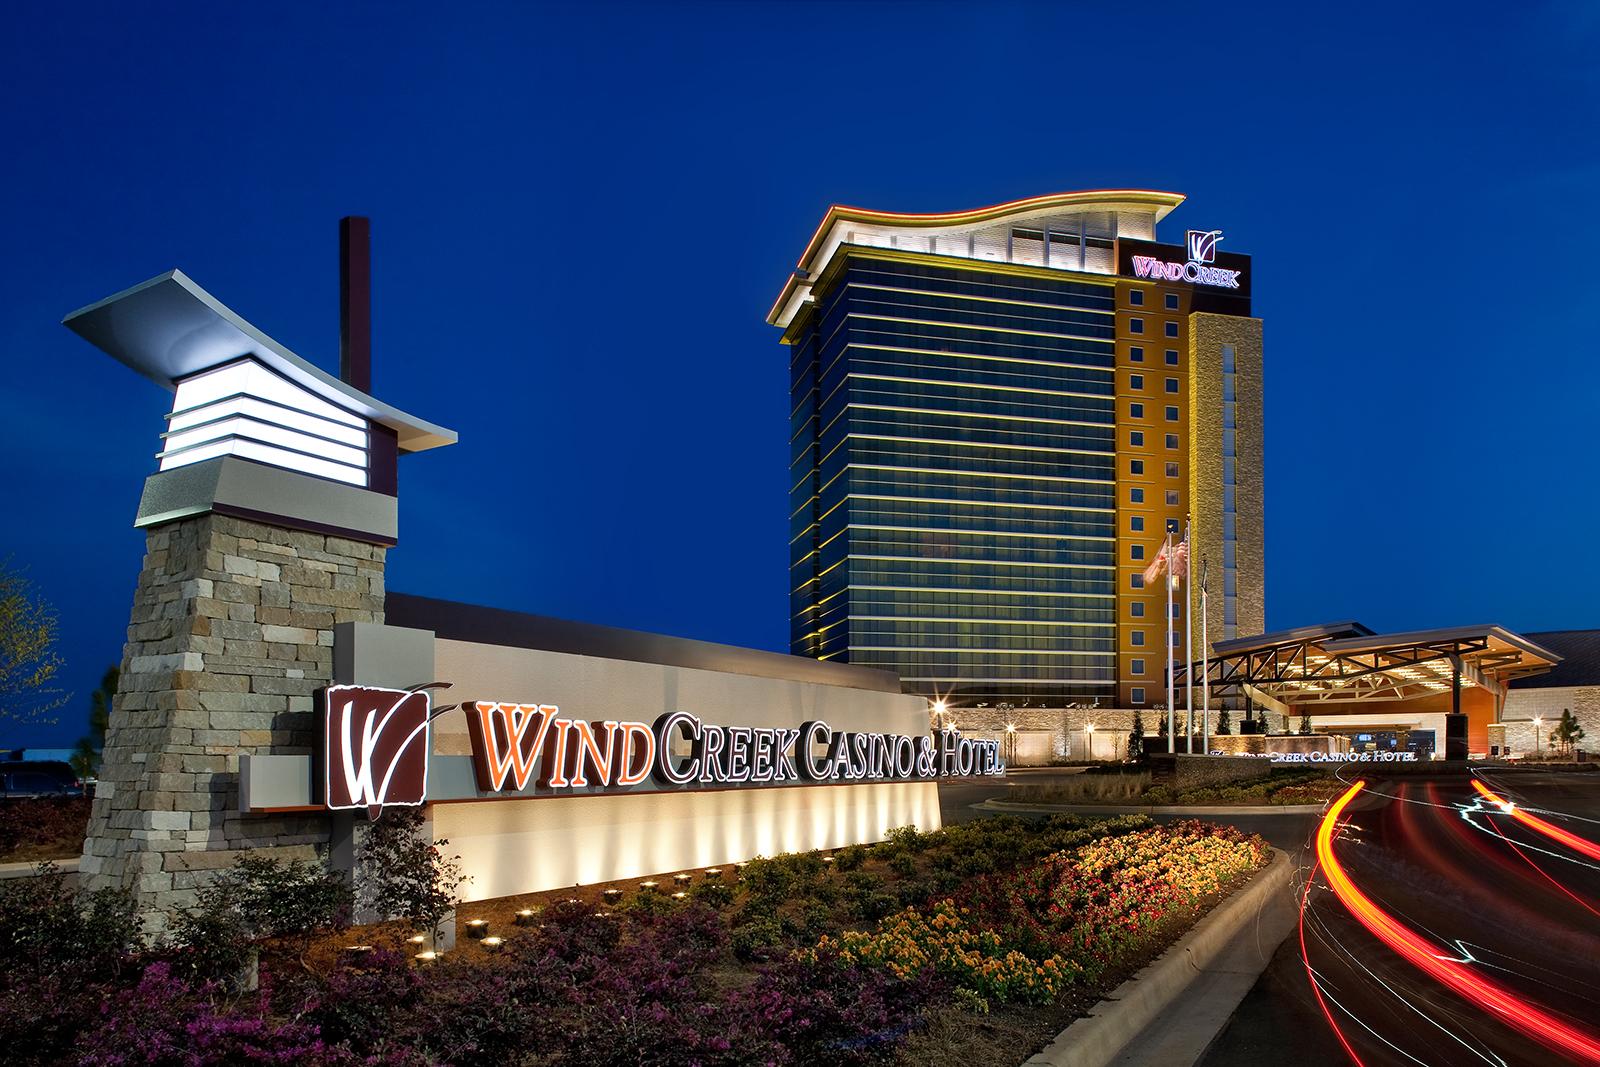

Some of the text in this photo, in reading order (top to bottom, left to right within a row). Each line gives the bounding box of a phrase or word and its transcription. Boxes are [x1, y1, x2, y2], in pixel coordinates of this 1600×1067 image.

[474, 700, 656, 793] WIND
[658, 711, 801, 785] CREEK
[804, 720, 915, 781] CASINO
[940, 729, 1005, 778] HOTEL
[1310, 751, 1359, 763] CASINO
[1372, 750, 1419, 763] HOTEL
